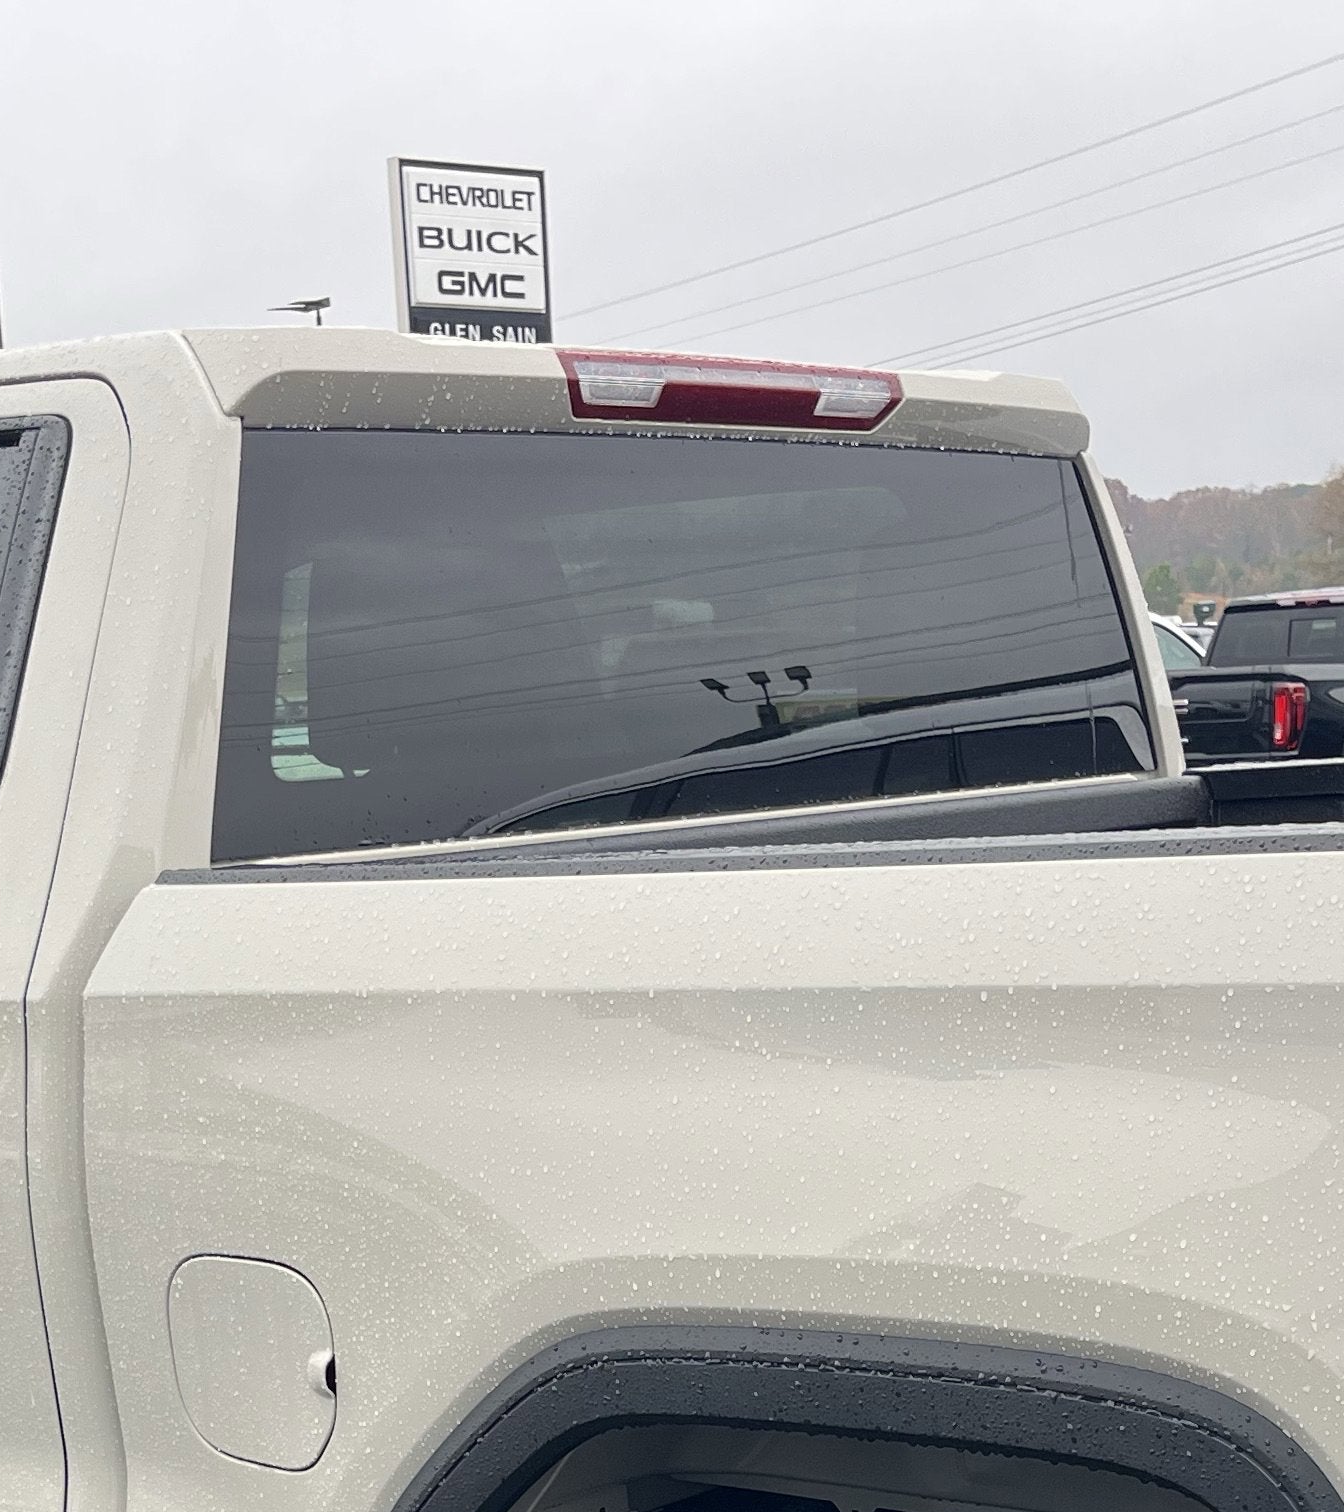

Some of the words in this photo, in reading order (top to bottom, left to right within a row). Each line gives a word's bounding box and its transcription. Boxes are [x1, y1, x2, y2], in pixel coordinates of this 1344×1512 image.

[415, 182, 535, 212] CHEVROLET
[417, 225, 539, 256] BUICK
[437, 269, 526, 300] GMC
[492, 325, 537, 344] SAIN
